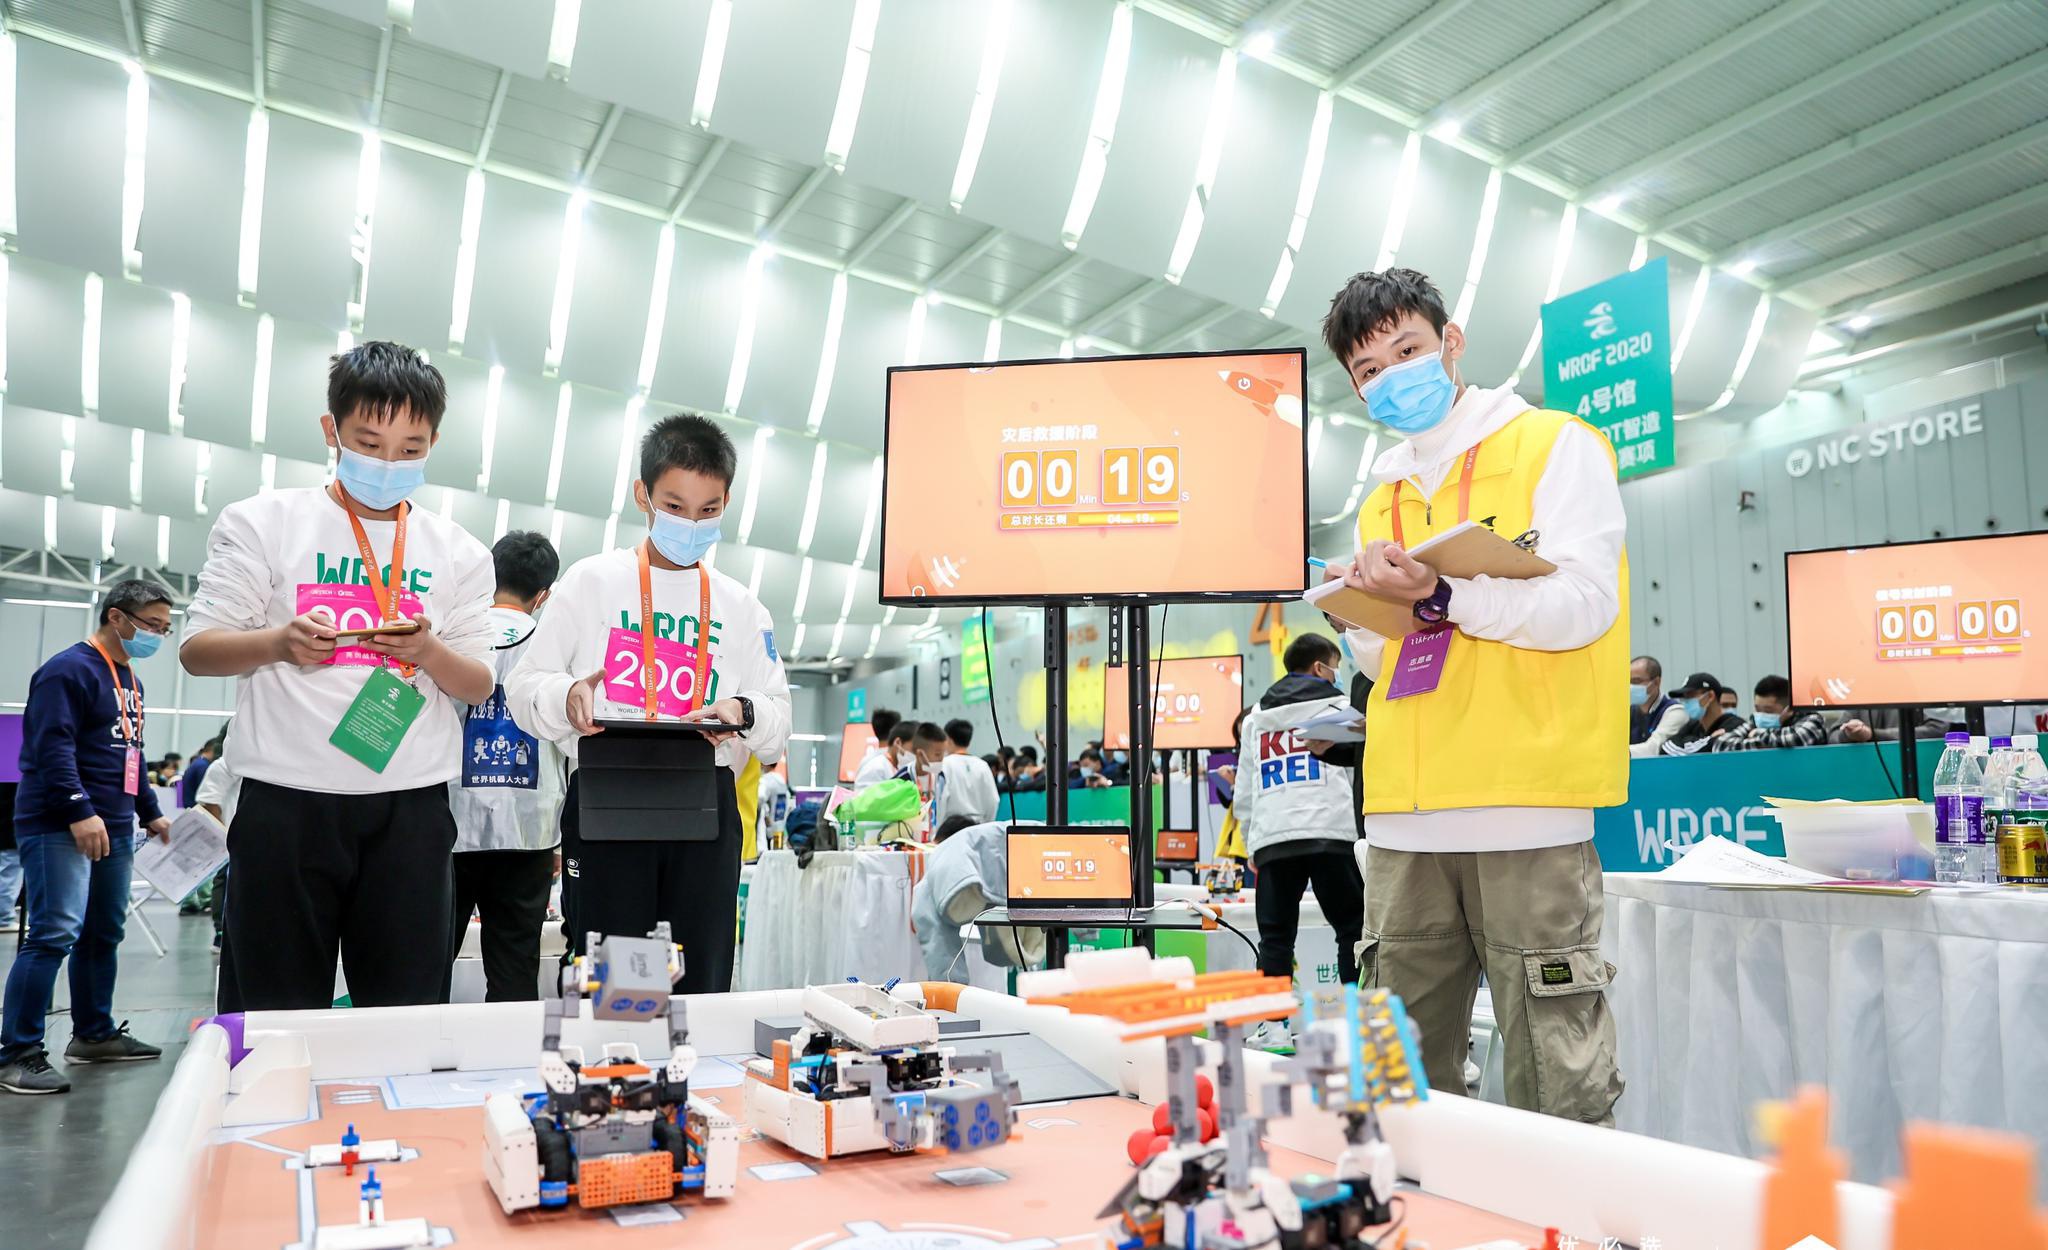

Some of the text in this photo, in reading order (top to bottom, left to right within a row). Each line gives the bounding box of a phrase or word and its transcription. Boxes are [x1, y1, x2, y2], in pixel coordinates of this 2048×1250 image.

[1557, 331, 1652, 382] WRCF 2020
[1576, 378, 1637, 417] 4号馆
[1817, 403, 1983, 469] NC STORE
[1007, 458, 1073, 498] 00
[1109, 454, 1175, 495] 19
[1881, 604, 2018, 640] 00 00
[471, 775, 529, 785] 世界机器人大赛
[1044, 859, 1095, 873] 00 19
